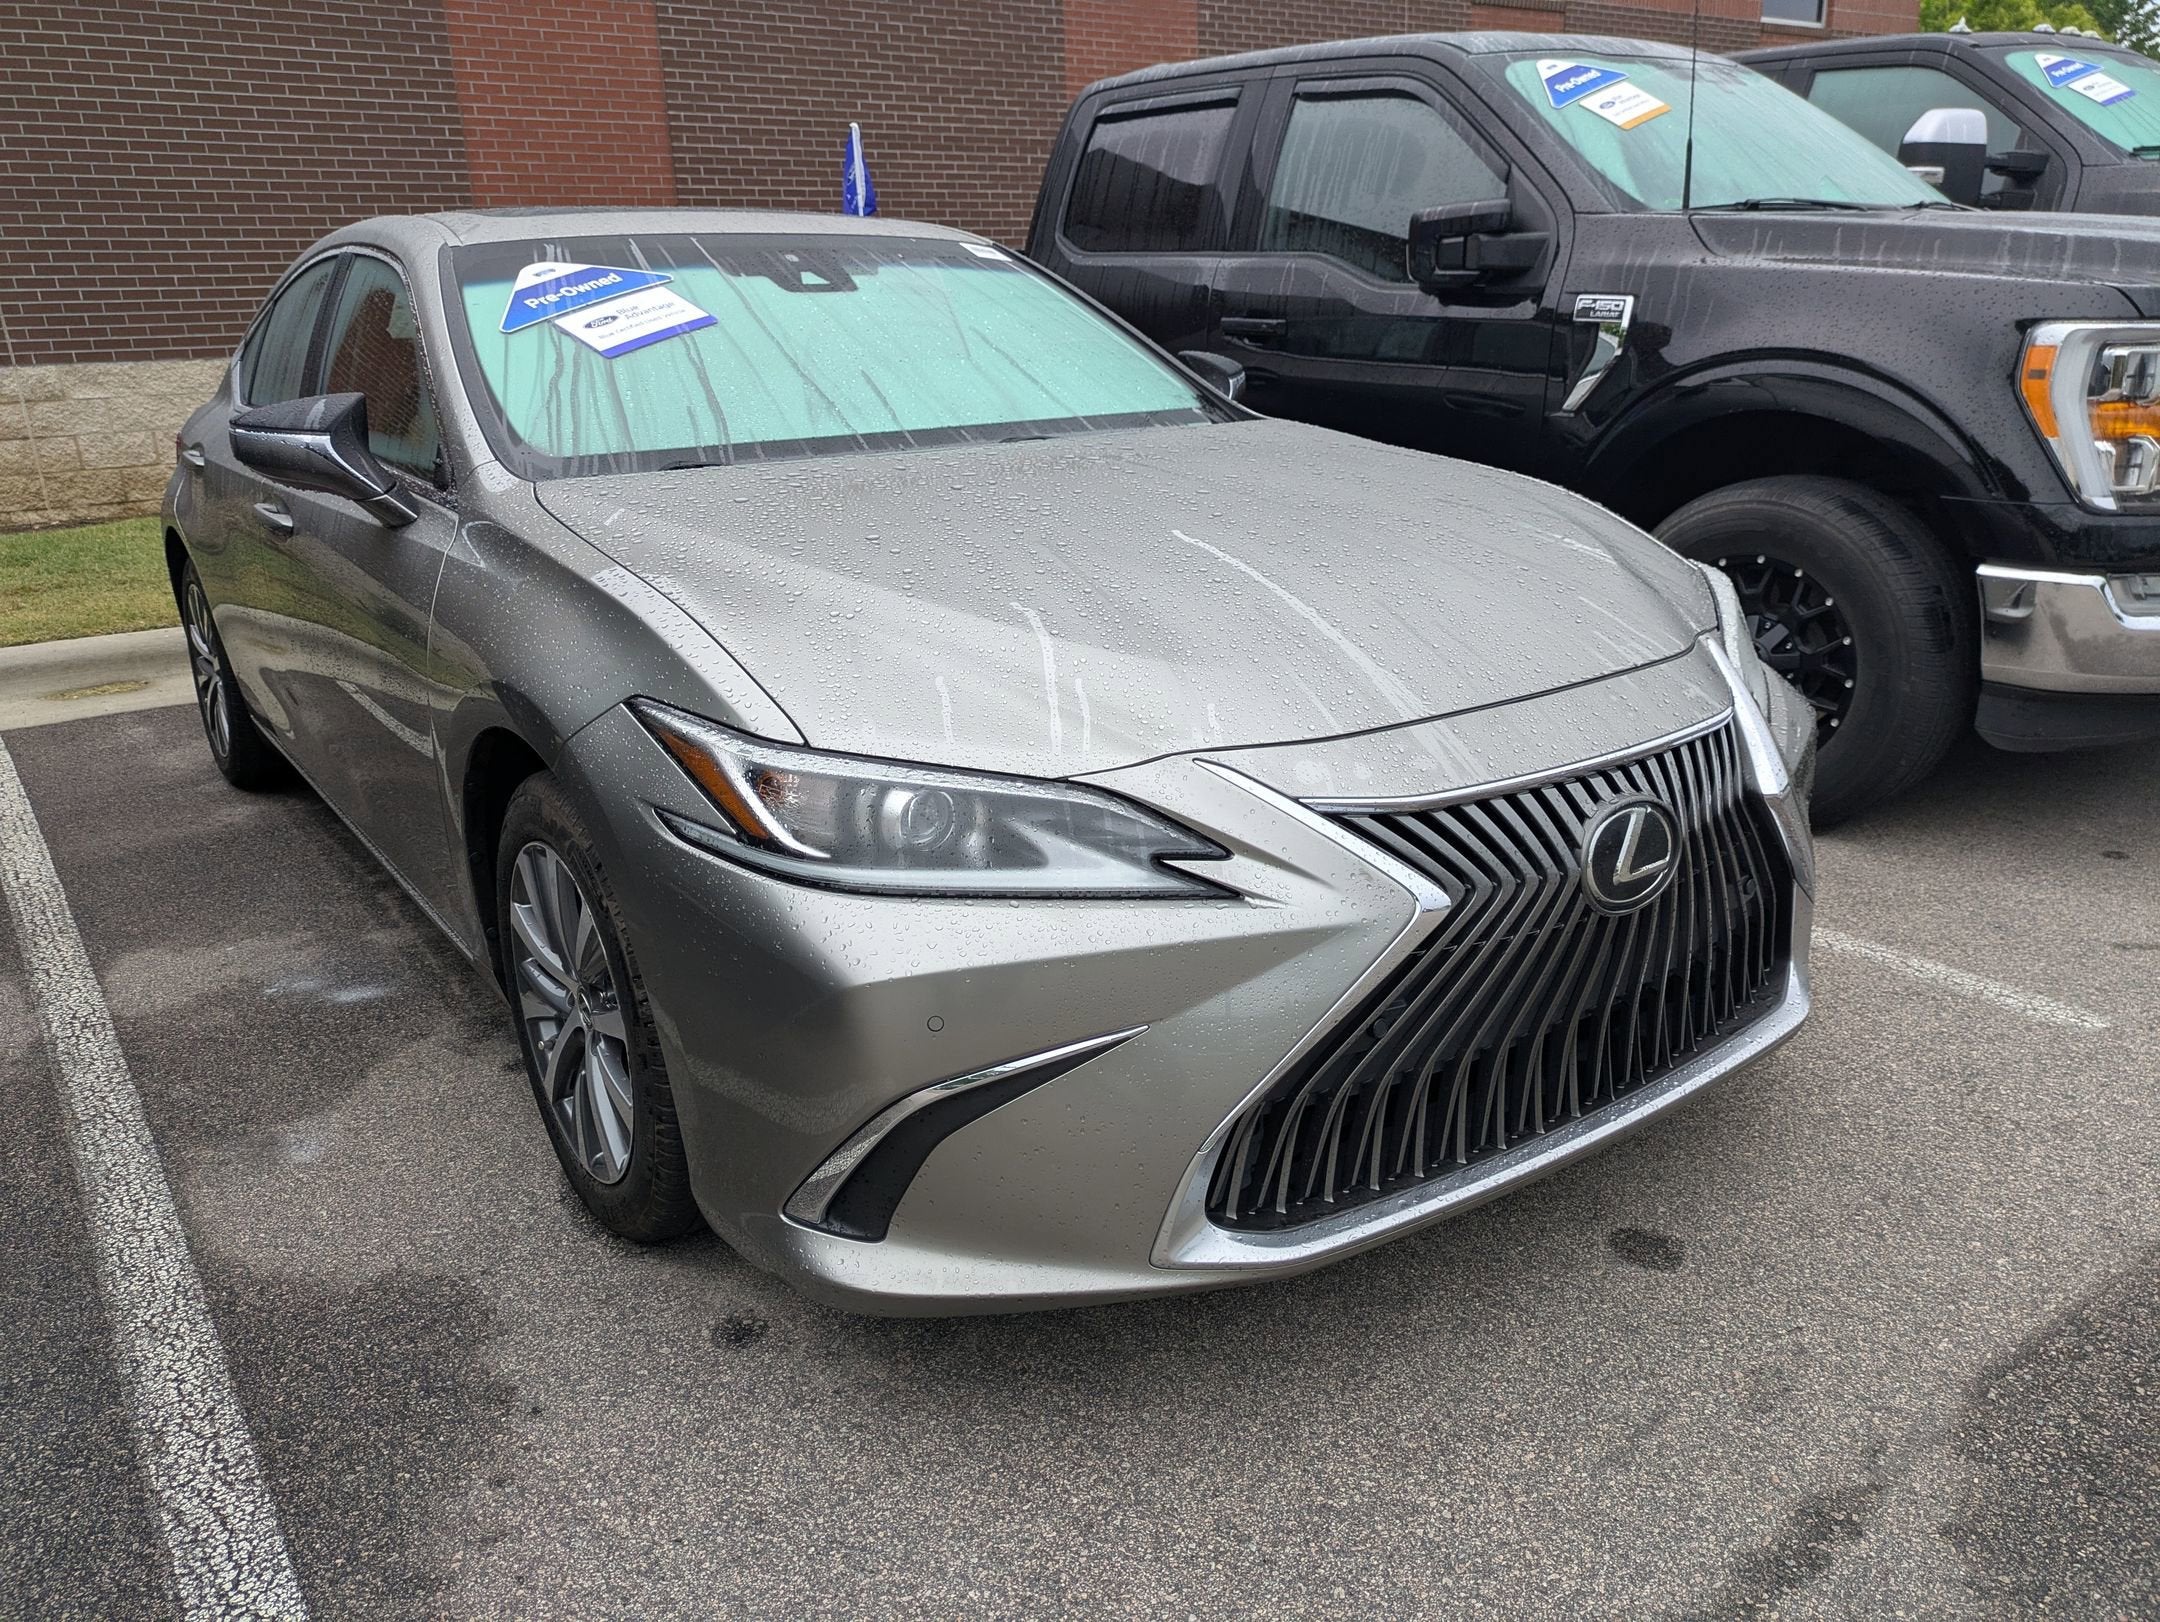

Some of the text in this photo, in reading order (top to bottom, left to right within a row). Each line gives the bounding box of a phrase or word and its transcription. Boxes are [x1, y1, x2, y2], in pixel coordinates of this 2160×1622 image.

[1554, 70, 1601, 93] Pre-Owned
[523, 272, 623, 309] Pre-Owned
[615, 304, 639, 316] Blue
[624, 302, 675, 320] Advantage
[1578, 299, 1625, 310] F-150
